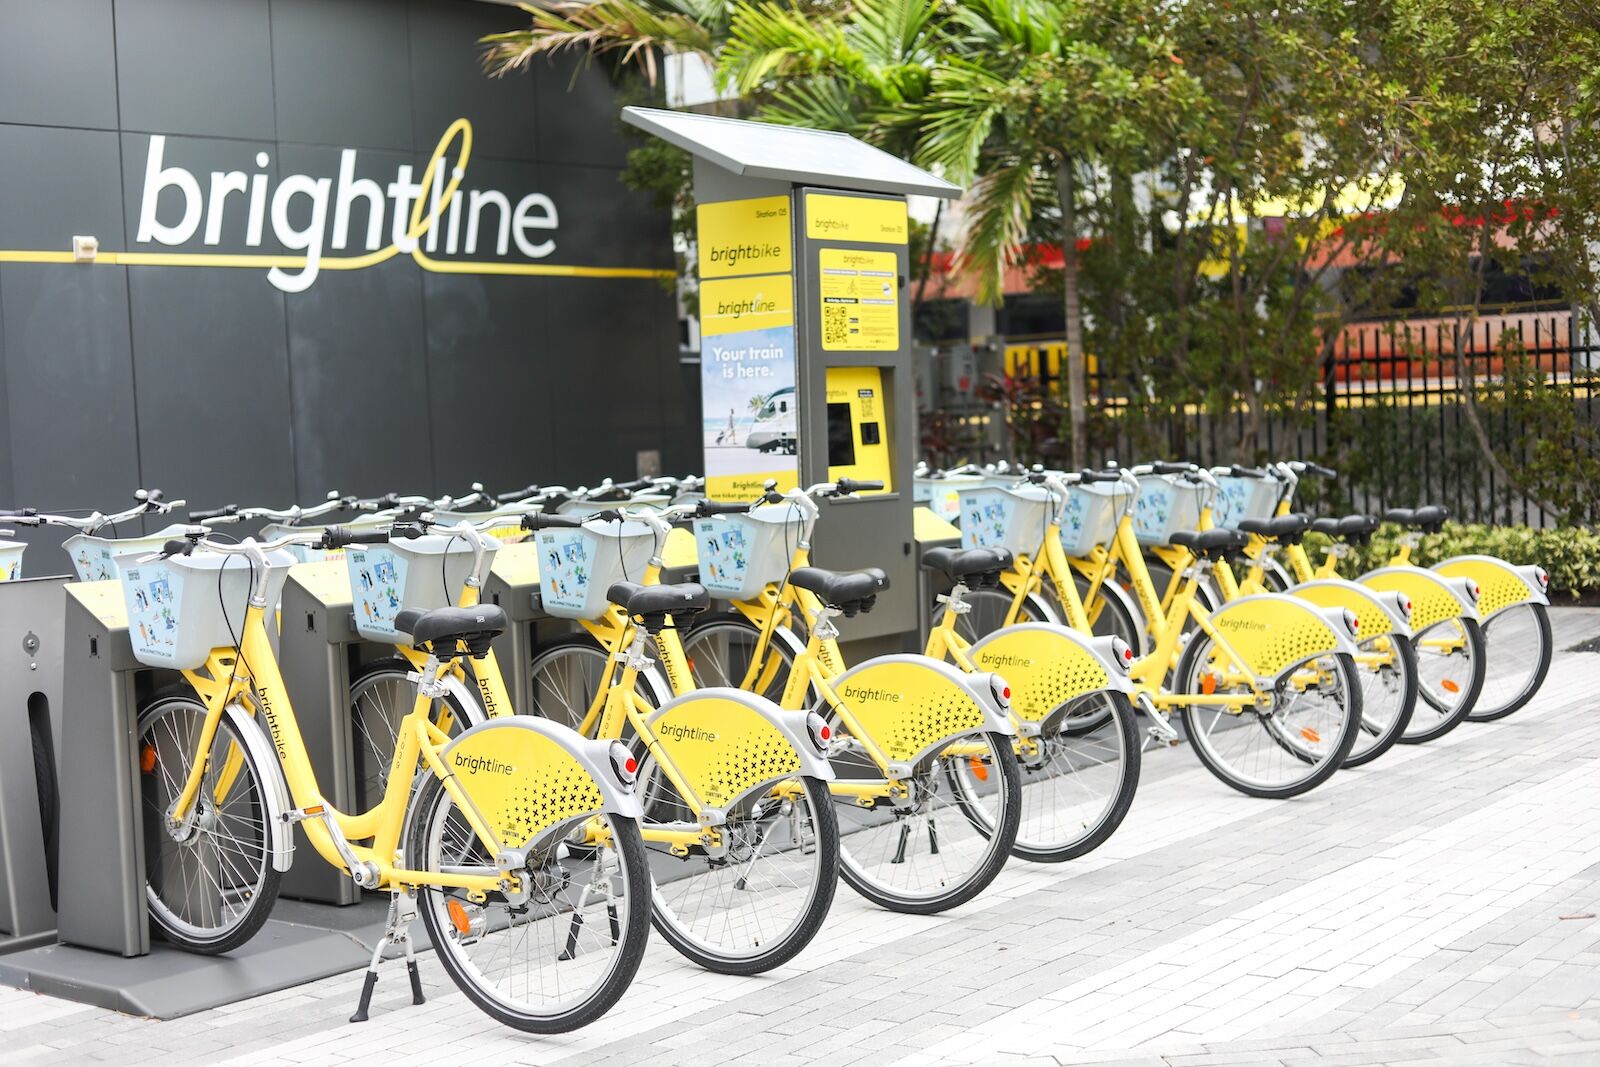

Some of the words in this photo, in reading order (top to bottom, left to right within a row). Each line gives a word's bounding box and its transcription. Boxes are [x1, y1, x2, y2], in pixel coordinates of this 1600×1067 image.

[136, 118, 559, 293] brightline
[710, 244, 781, 266] brightbike
[717, 292, 775, 318] brightline
[712, 346, 746, 362] Your
[749, 344, 784, 360] train
[722, 364, 736, 378] is
[737, 361, 775, 377] here.
[1219, 617, 1266, 632] brightline
[981, 652, 1031, 668] brightline
[479, 678, 499, 719] bright
[844, 685, 900, 704] brightline
[258, 687, 287, 760] brightbike
[660, 722, 716, 743] brightline
[455, 751, 513, 775] brightline
